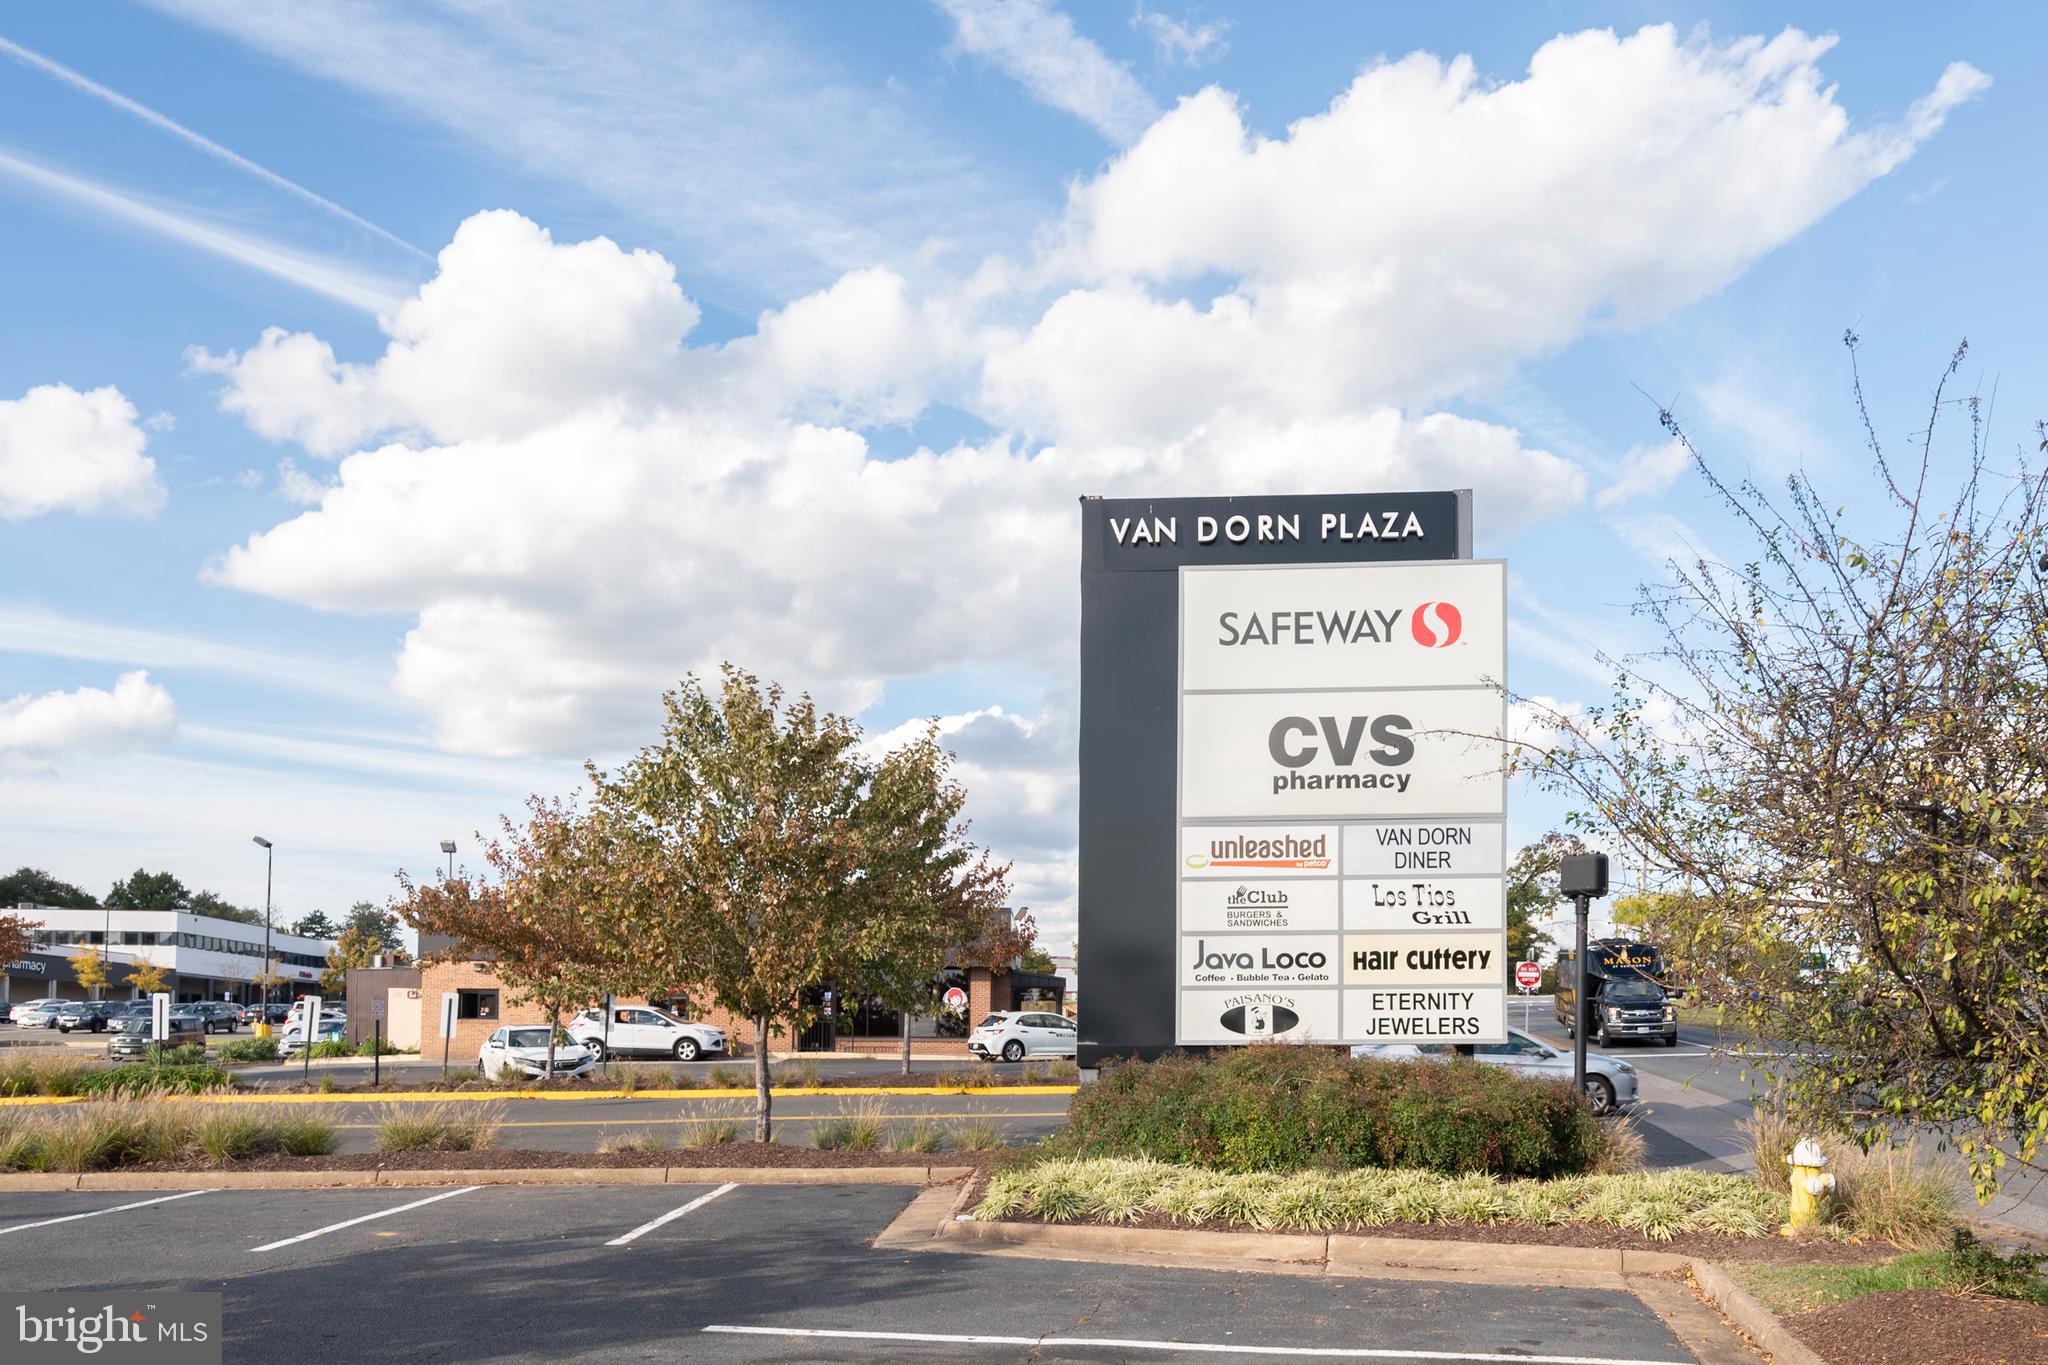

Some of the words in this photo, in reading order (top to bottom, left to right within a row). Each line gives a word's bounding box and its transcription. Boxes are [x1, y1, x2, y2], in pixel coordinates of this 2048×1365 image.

[1109, 515, 1177, 545] VAN
[1197, 513, 1300, 544] DORN
[1321, 510, 1424, 540] PLAZA
[1218, 609, 1403, 646] SAFEWAY
[1268, 714, 1415, 768] CVS
[1272, 770, 1411, 794] pharmacy
[1375, 828, 1412, 846] VAN
[1418, 827, 1471, 845] DORN
[1210, 834, 1326, 859] unleashed
[1395, 851, 1451, 869] DINER
[1247, 890, 1288, 904] Club
[1372, 884, 1407, 907] Los
[1412, 884, 1455, 906] Tios
[1226, 911, 1272, 919] BURGERS
[1227, 919, 1288, 927] SANDWICHES
[1412, 911, 1472, 925] Grill
[1193, 940, 1254, 970] Java
[1262, 947, 1327, 969] Loco
[1353, 950, 1398, 970] Hair
[1406, 947, 1491, 970] cuttery
[1195, 974, 1226, 982] Coffee
[1236, 973, 1270, 982] Bubble
[1272, 973, 1290, 981] Tea
[1297, 973, 1329, 981] Gelato
[1224, 993, 1296, 1009] PAISANO'S
[1372, 992, 1474, 1010] ETERNITY
[1366, 1017, 1480, 1035] JEWELERS
